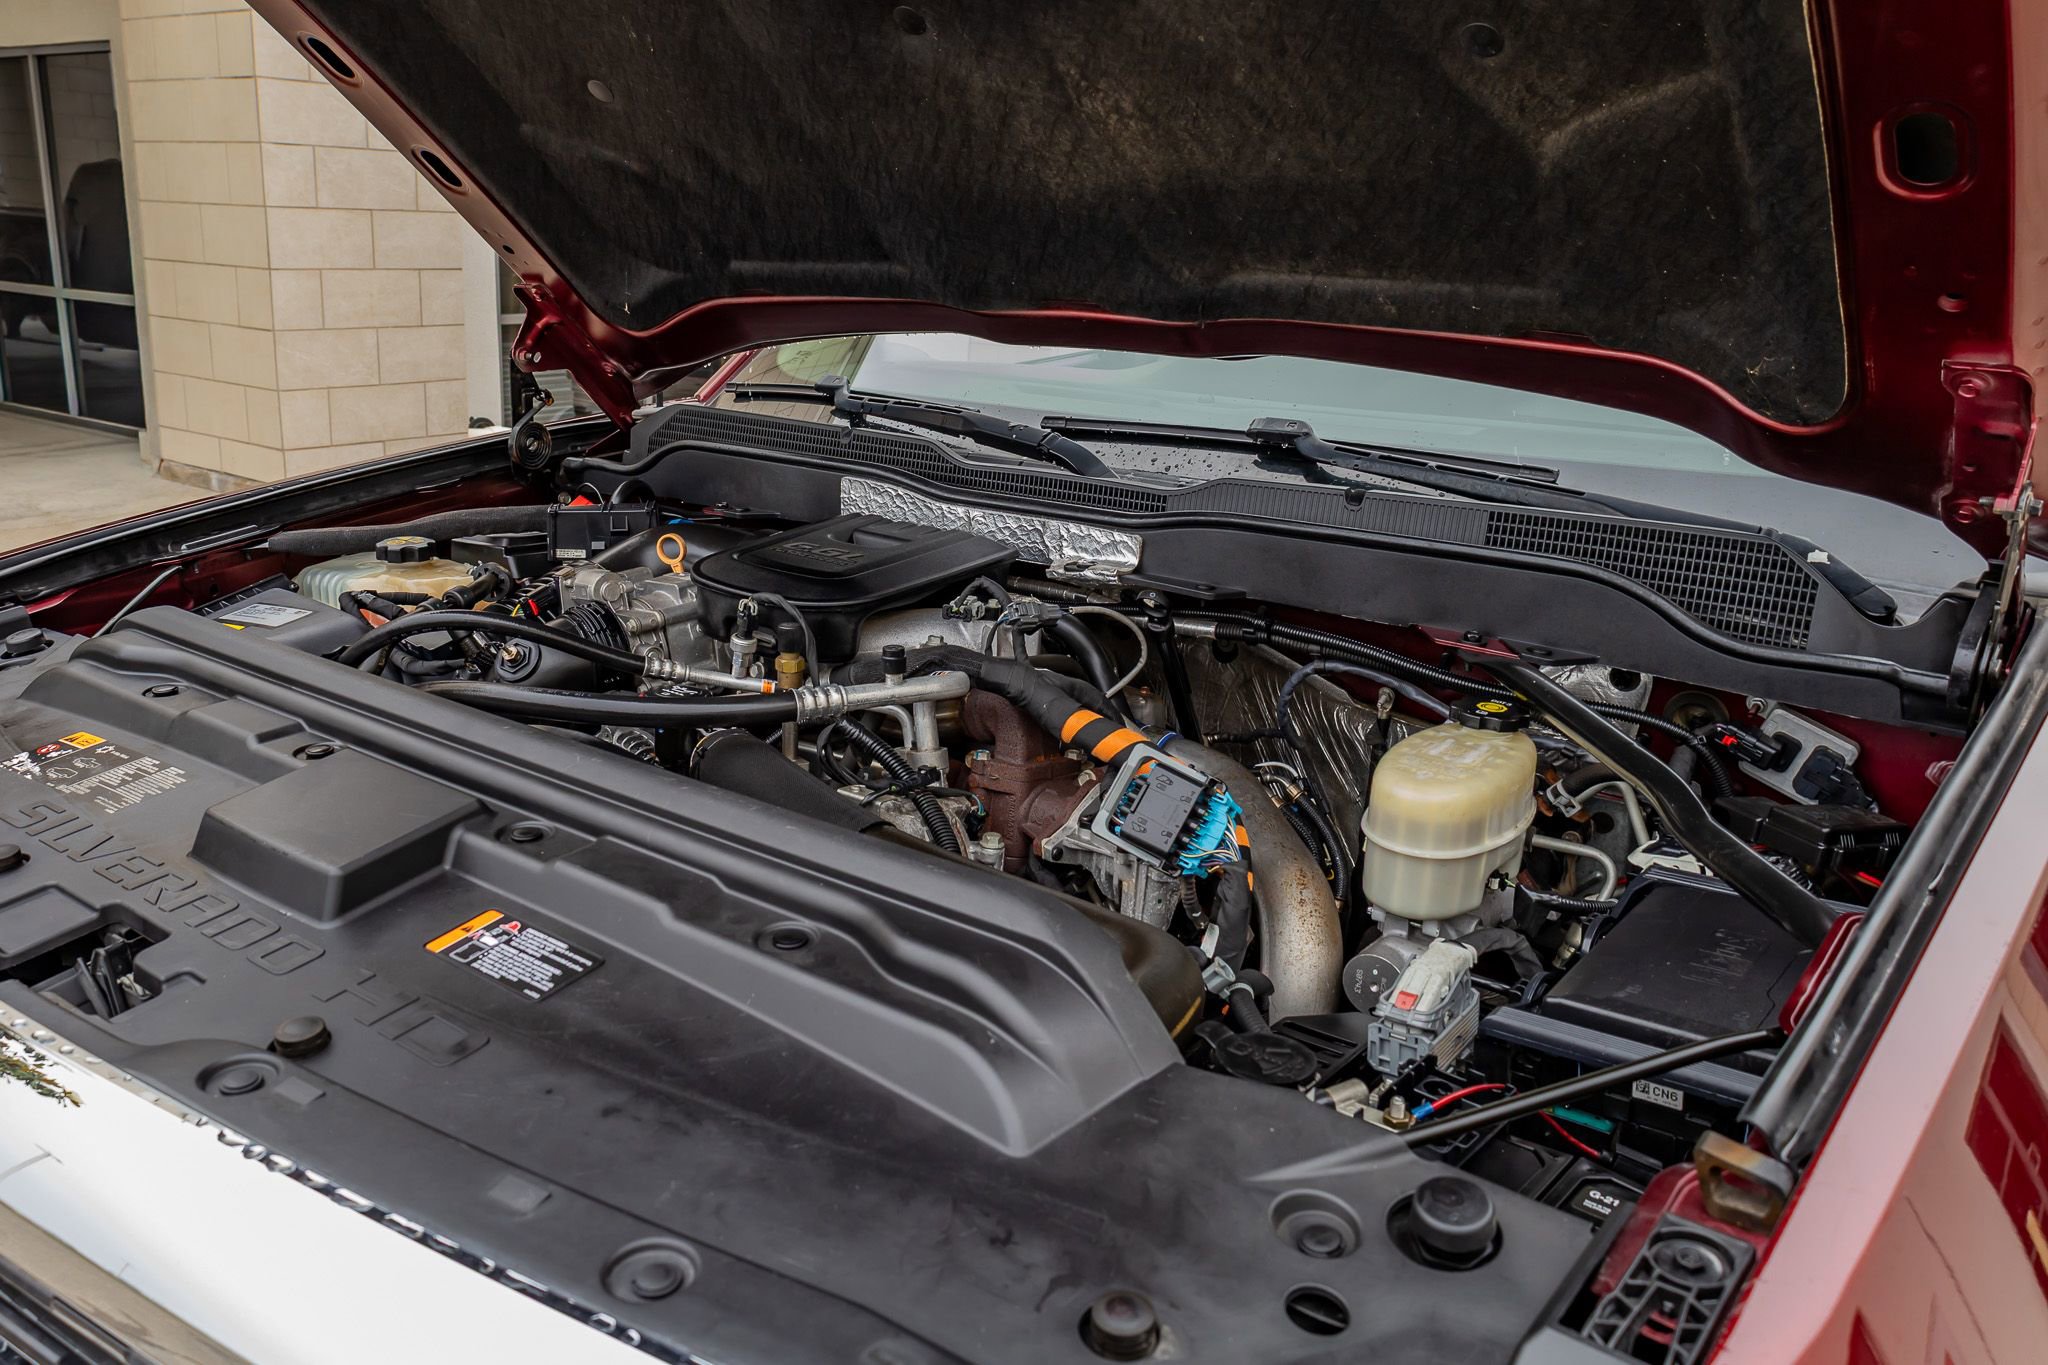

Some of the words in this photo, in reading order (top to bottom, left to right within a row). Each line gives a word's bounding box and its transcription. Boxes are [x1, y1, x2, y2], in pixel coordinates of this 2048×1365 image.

[0, 802, 327, 975] SILVERADO
[311, 969, 491, 1068] HD
[1652, 1086, 1678, 1102] CN6
